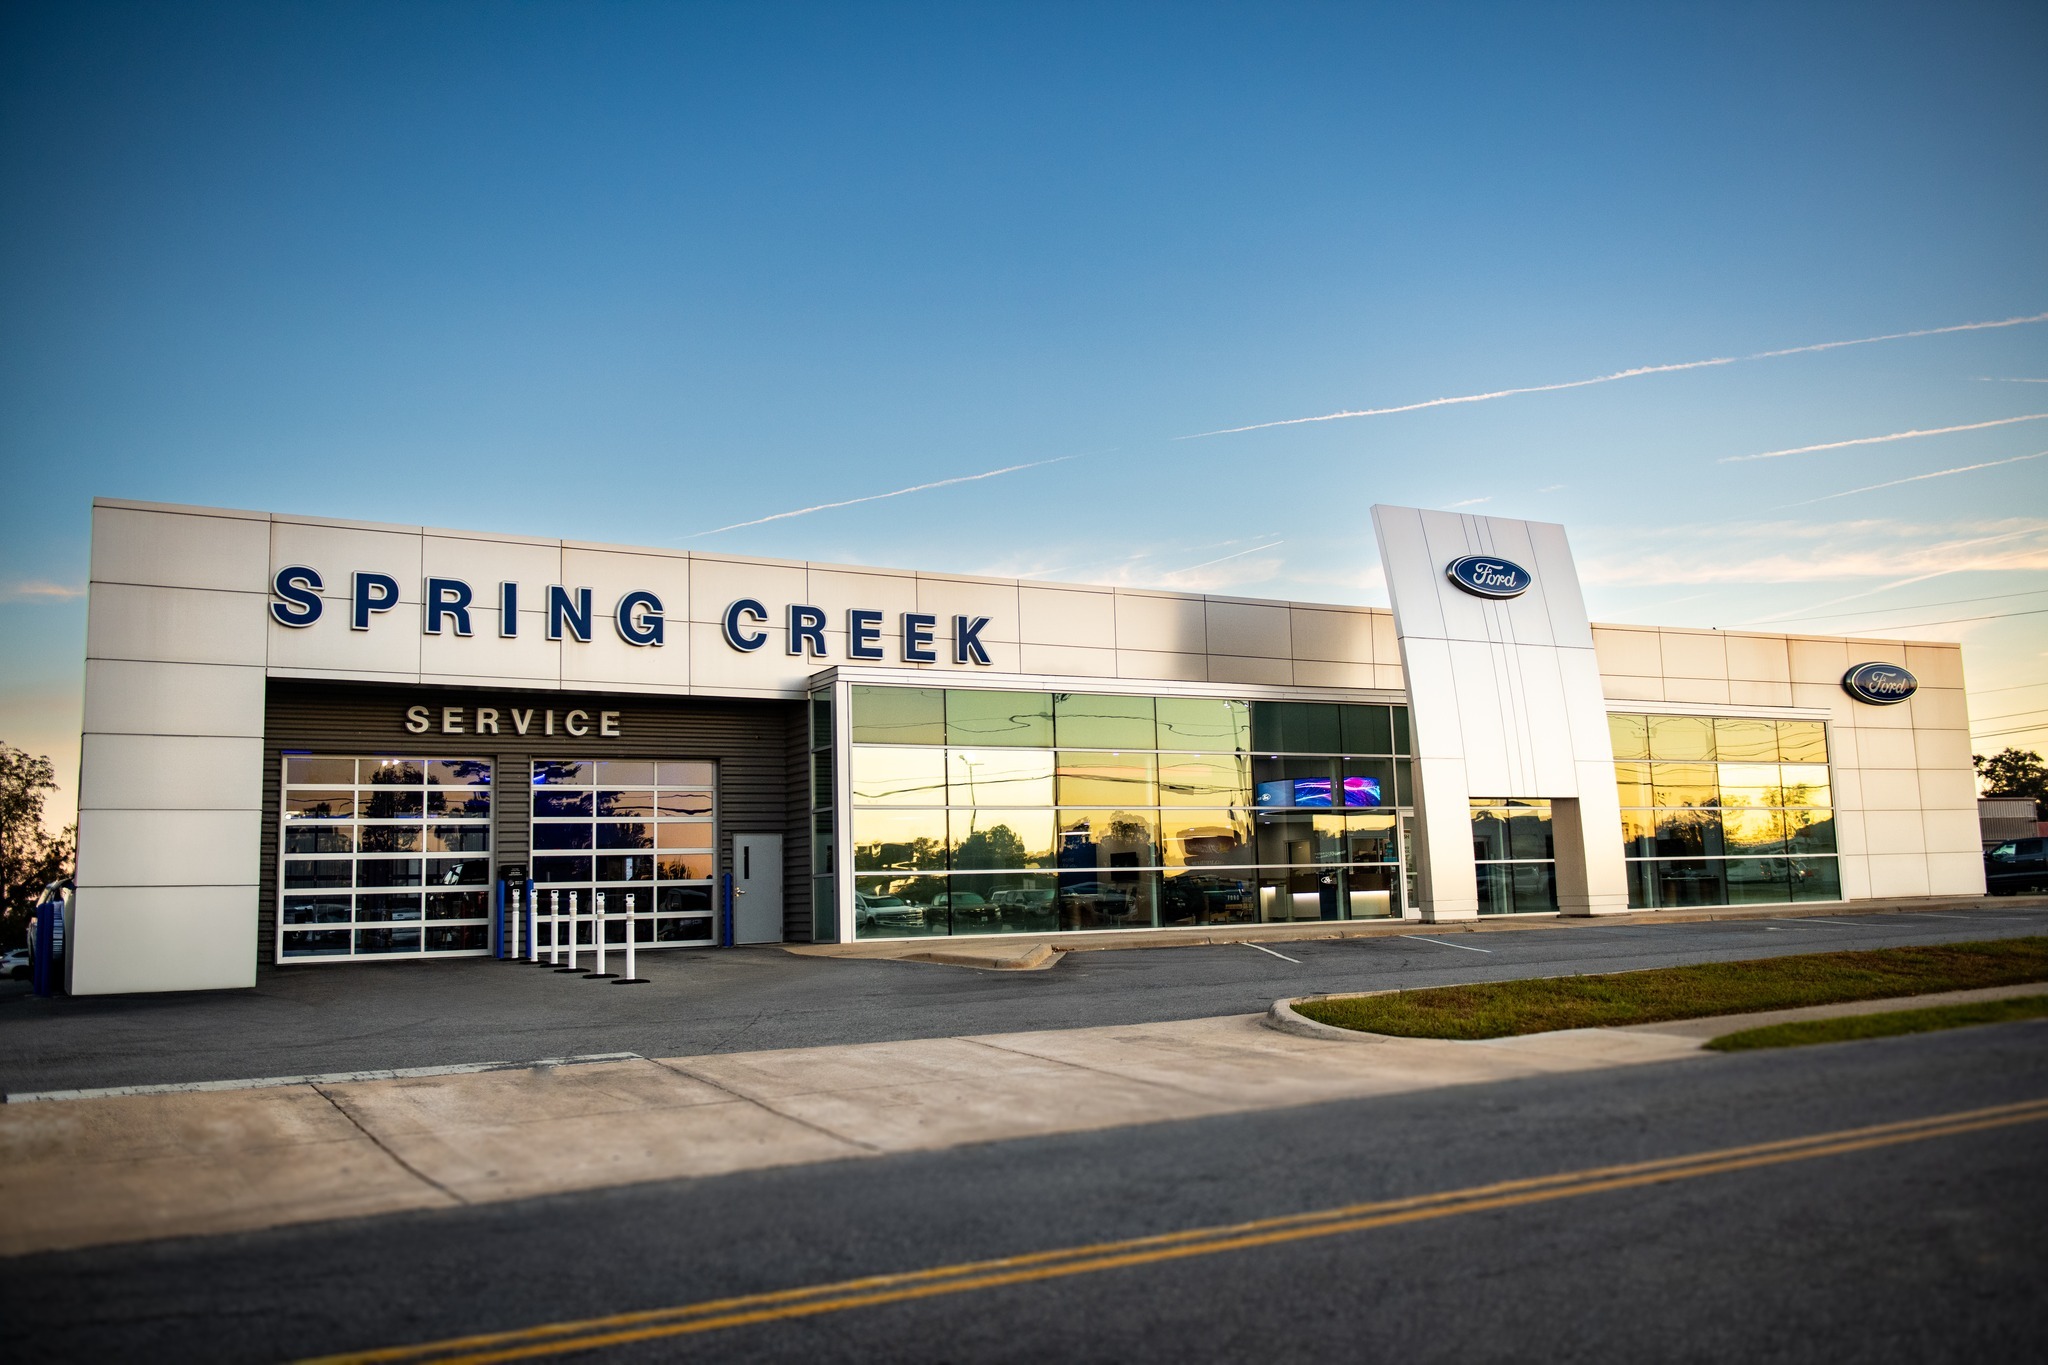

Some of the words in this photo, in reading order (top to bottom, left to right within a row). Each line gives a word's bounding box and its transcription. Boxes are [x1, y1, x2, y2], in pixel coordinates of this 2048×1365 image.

[1473, 562, 1516, 587] Ford
[270, 564, 666, 647] SPRING
[722, 597, 993, 665] CREEK
[1868, 671, 1907, 694] Ford
[404, 705, 622, 738] SERVICE
